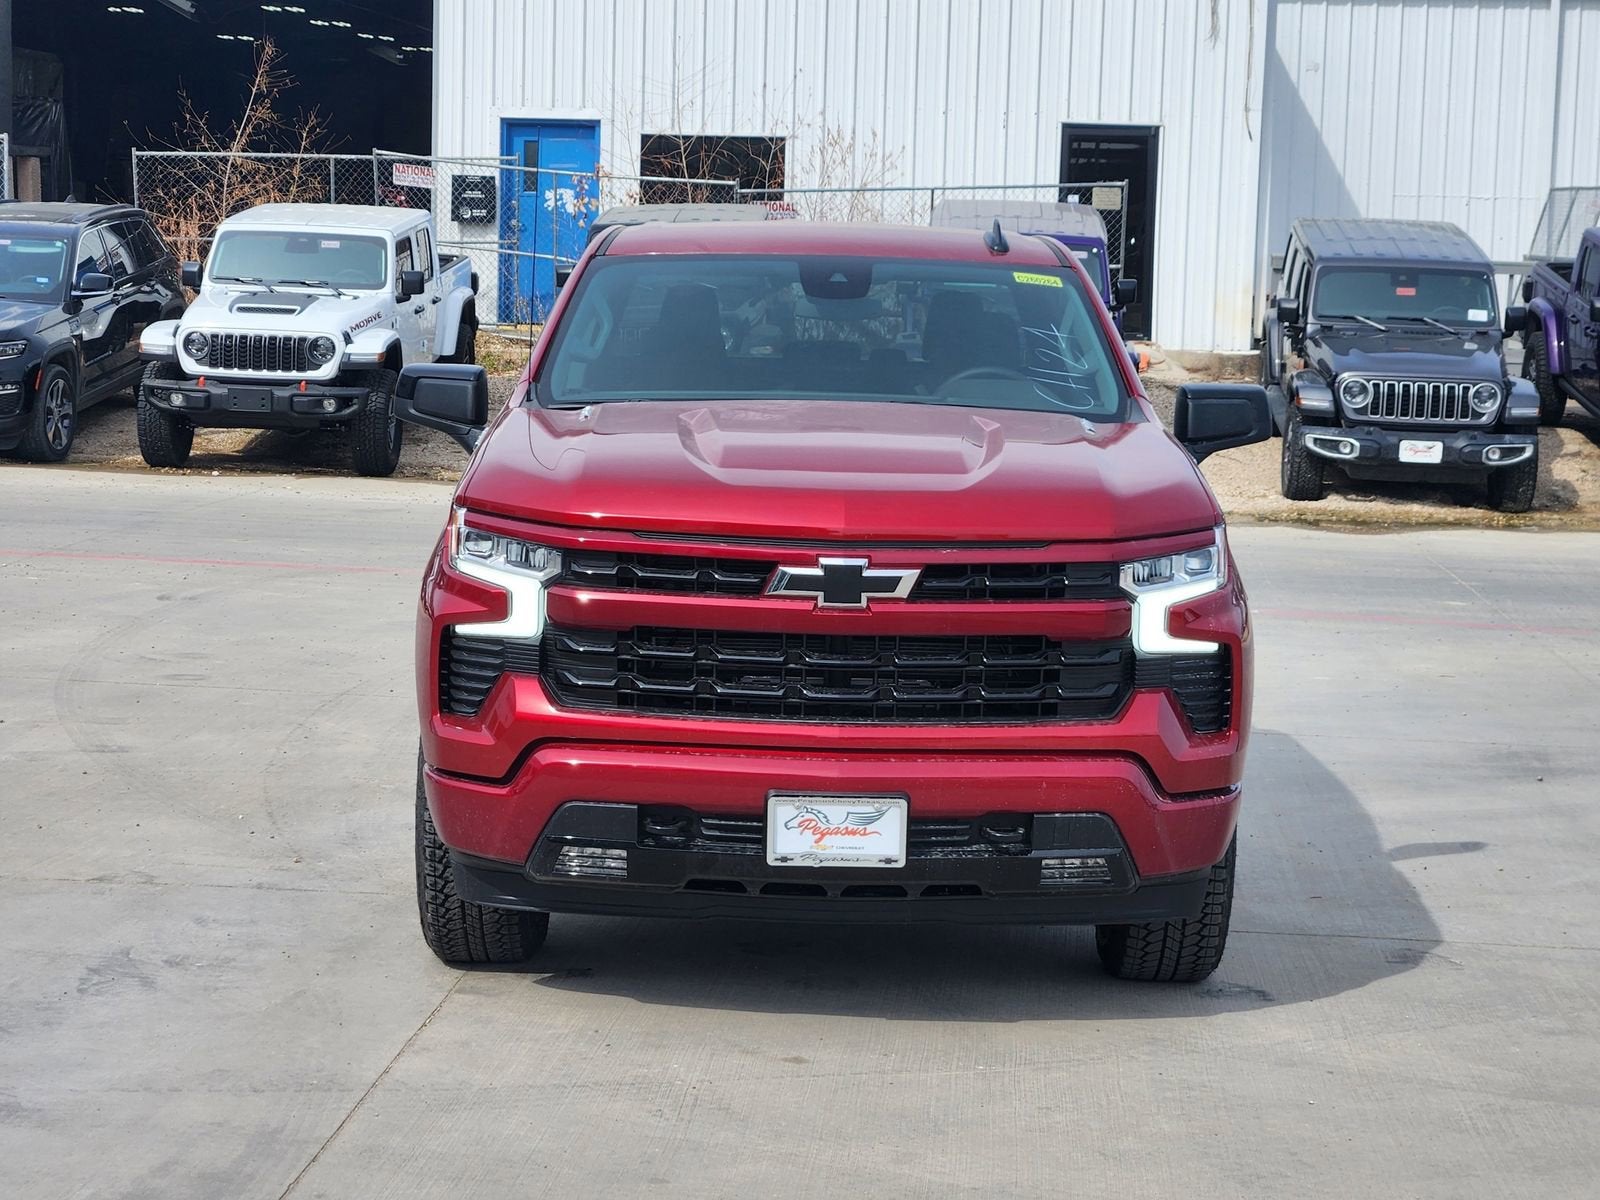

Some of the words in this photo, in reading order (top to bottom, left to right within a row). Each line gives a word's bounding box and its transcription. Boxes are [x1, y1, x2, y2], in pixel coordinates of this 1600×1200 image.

[394, 164, 436, 178] NATIONAL
[349, 311, 383, 333] MOJAVE
[799, 818, 882, 844] Pegasus
